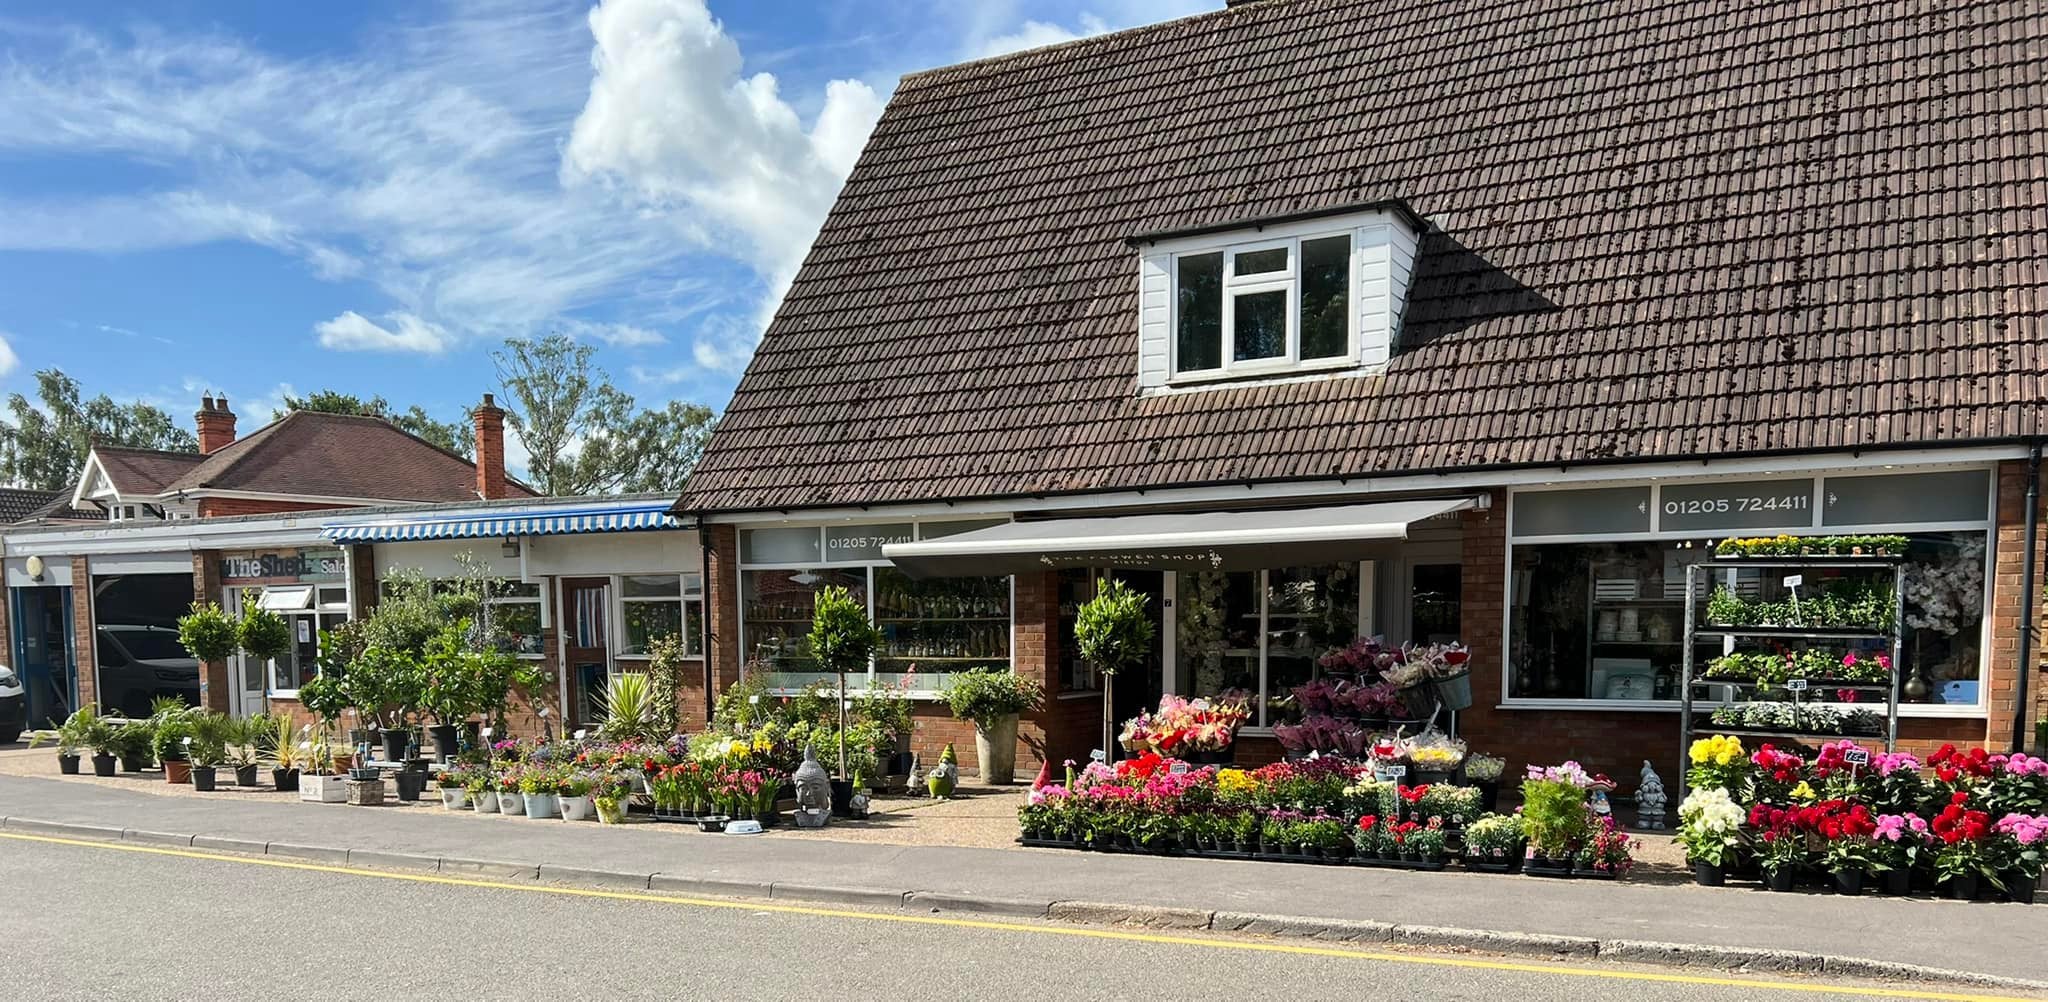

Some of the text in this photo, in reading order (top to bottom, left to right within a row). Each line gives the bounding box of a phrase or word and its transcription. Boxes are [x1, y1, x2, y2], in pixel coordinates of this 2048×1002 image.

[1665, 495, 1807, 514] 01205 724411
[829, 537, 867, 549] 01205
[1160, 553, 1206, 561] SHOP
